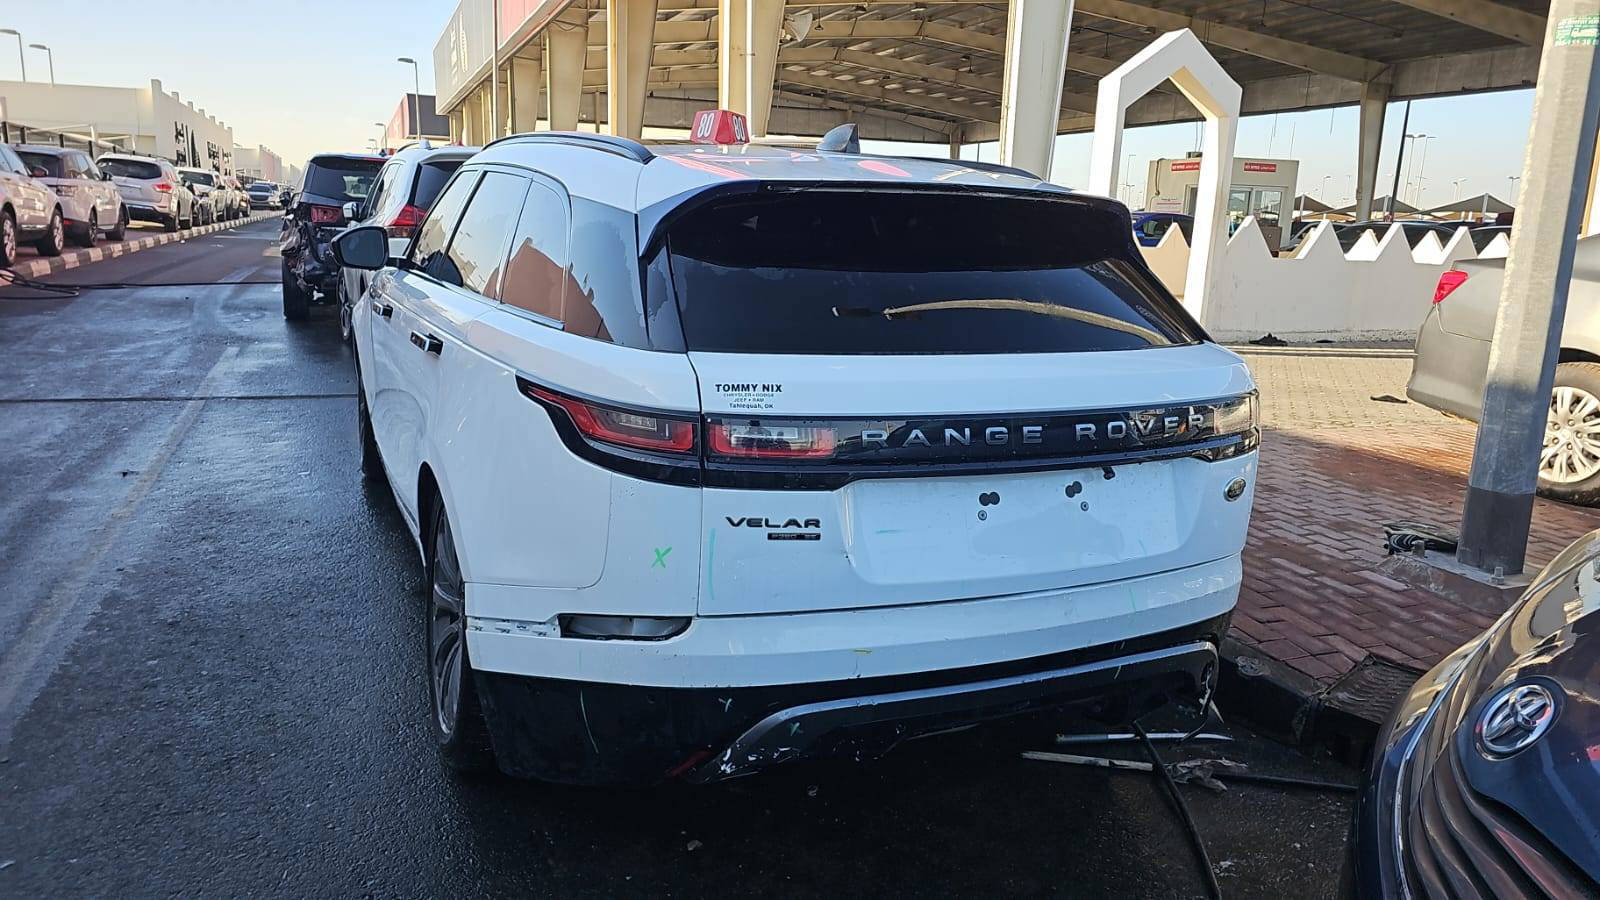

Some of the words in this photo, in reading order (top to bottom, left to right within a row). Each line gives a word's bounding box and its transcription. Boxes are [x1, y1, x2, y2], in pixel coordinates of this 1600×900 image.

[715, 383, 758, 392] TOMMY
[762, 383, 782, 392] NIX
[861, 424, 1044, 448] RANGE
[1075, 414, 1205, 441] ROVER
[725, 516, 821, 529] VELAR
